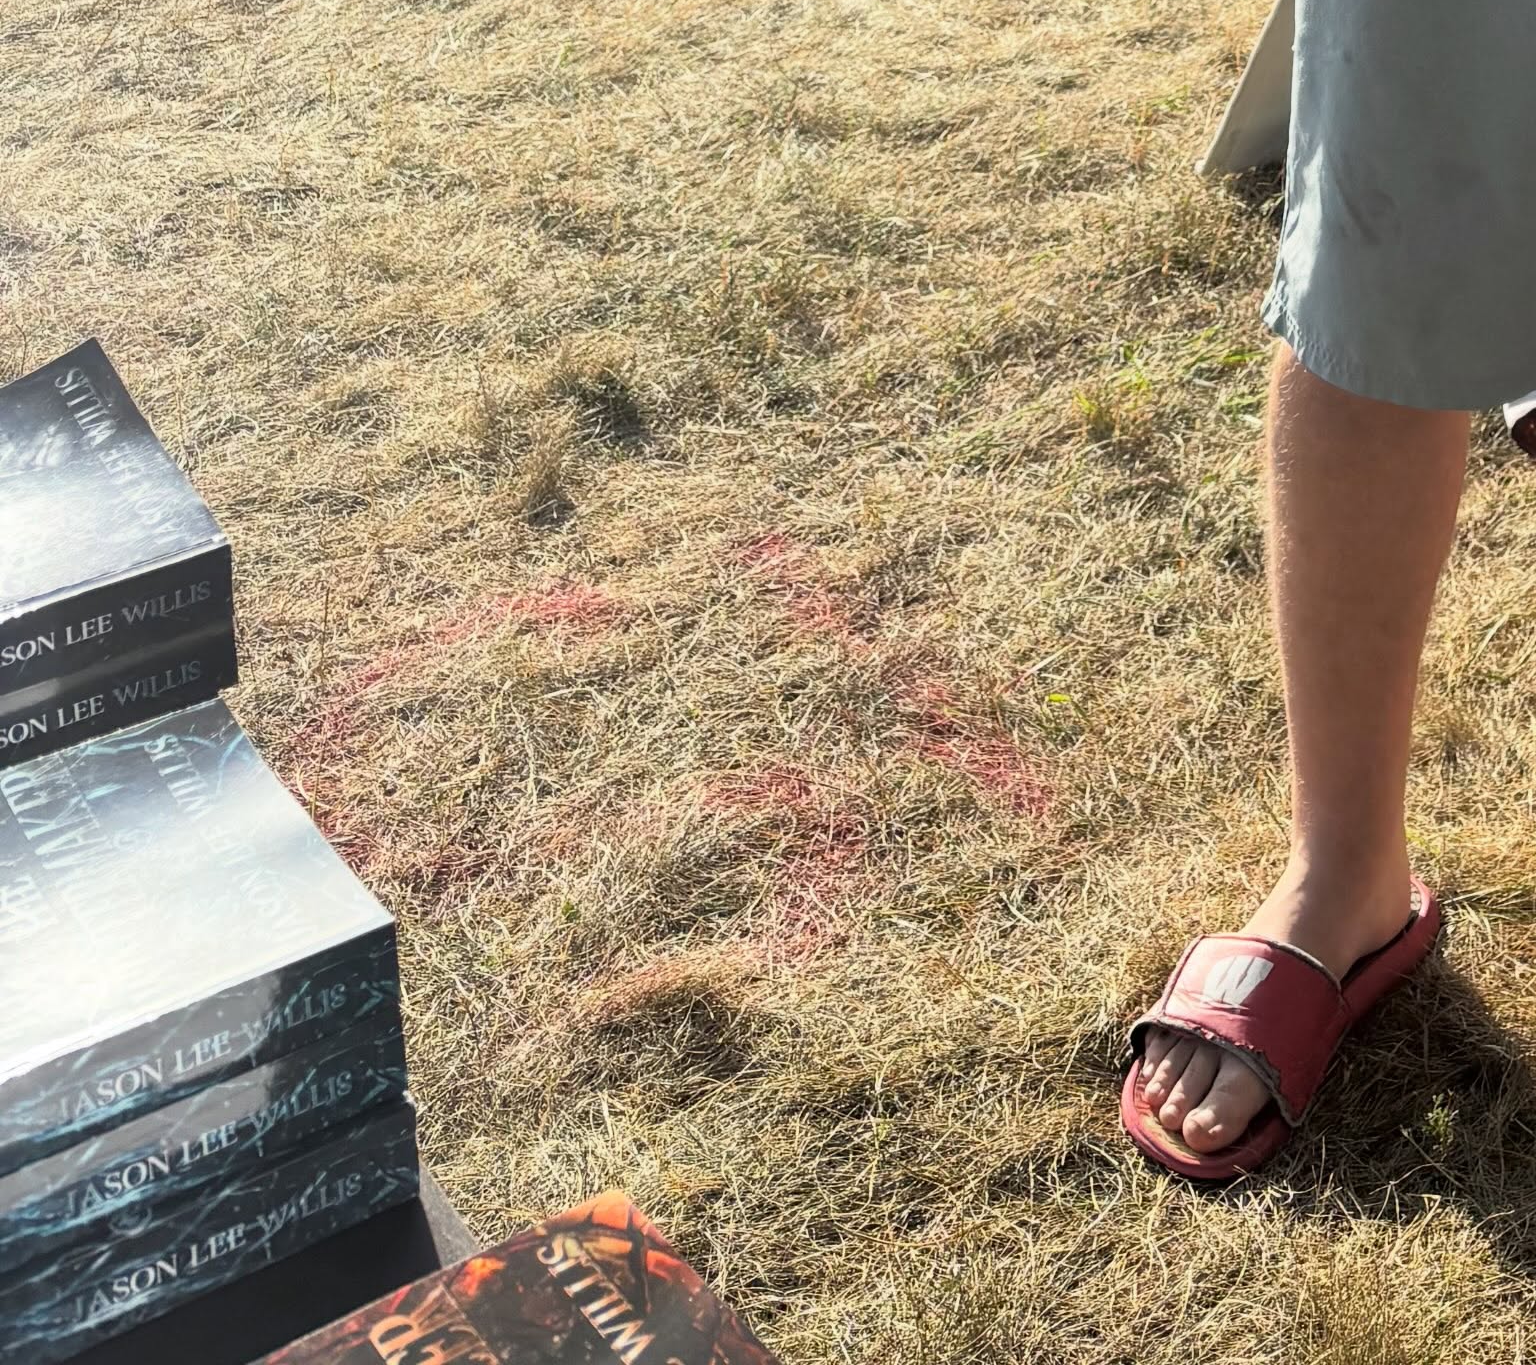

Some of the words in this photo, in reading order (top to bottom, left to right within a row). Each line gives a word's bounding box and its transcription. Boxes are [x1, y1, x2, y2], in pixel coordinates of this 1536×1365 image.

[55, 368, 117, 449] WILLIS
[65, 612, 114, 646] LEE
[122, 580, 212, 625] WILLIS
[57, 694, 105, 729] LEE
[113, 660, 202, 707] WILLIS
[144, 733, 217, 821] WILLIS
[1203, 955, 1274, 1008] W
[60, 1057, 164, 1119] JASON
[173, 1030, 231, 1074] LEE
[241, 982, 347, 1041] WILLIS
[66, 1149, 171, 1215] JASON
[181, 1119, 239, 1163] LEE
[249, 1070, 353, 1131] WILLIS
[75, 1253, 179, 1316] JASON
[188, 1221, 247, 1267] LEE
[258, 1172, 362, 1234] WILLIS
[537, 1235, 656, 1365] WILLIS
